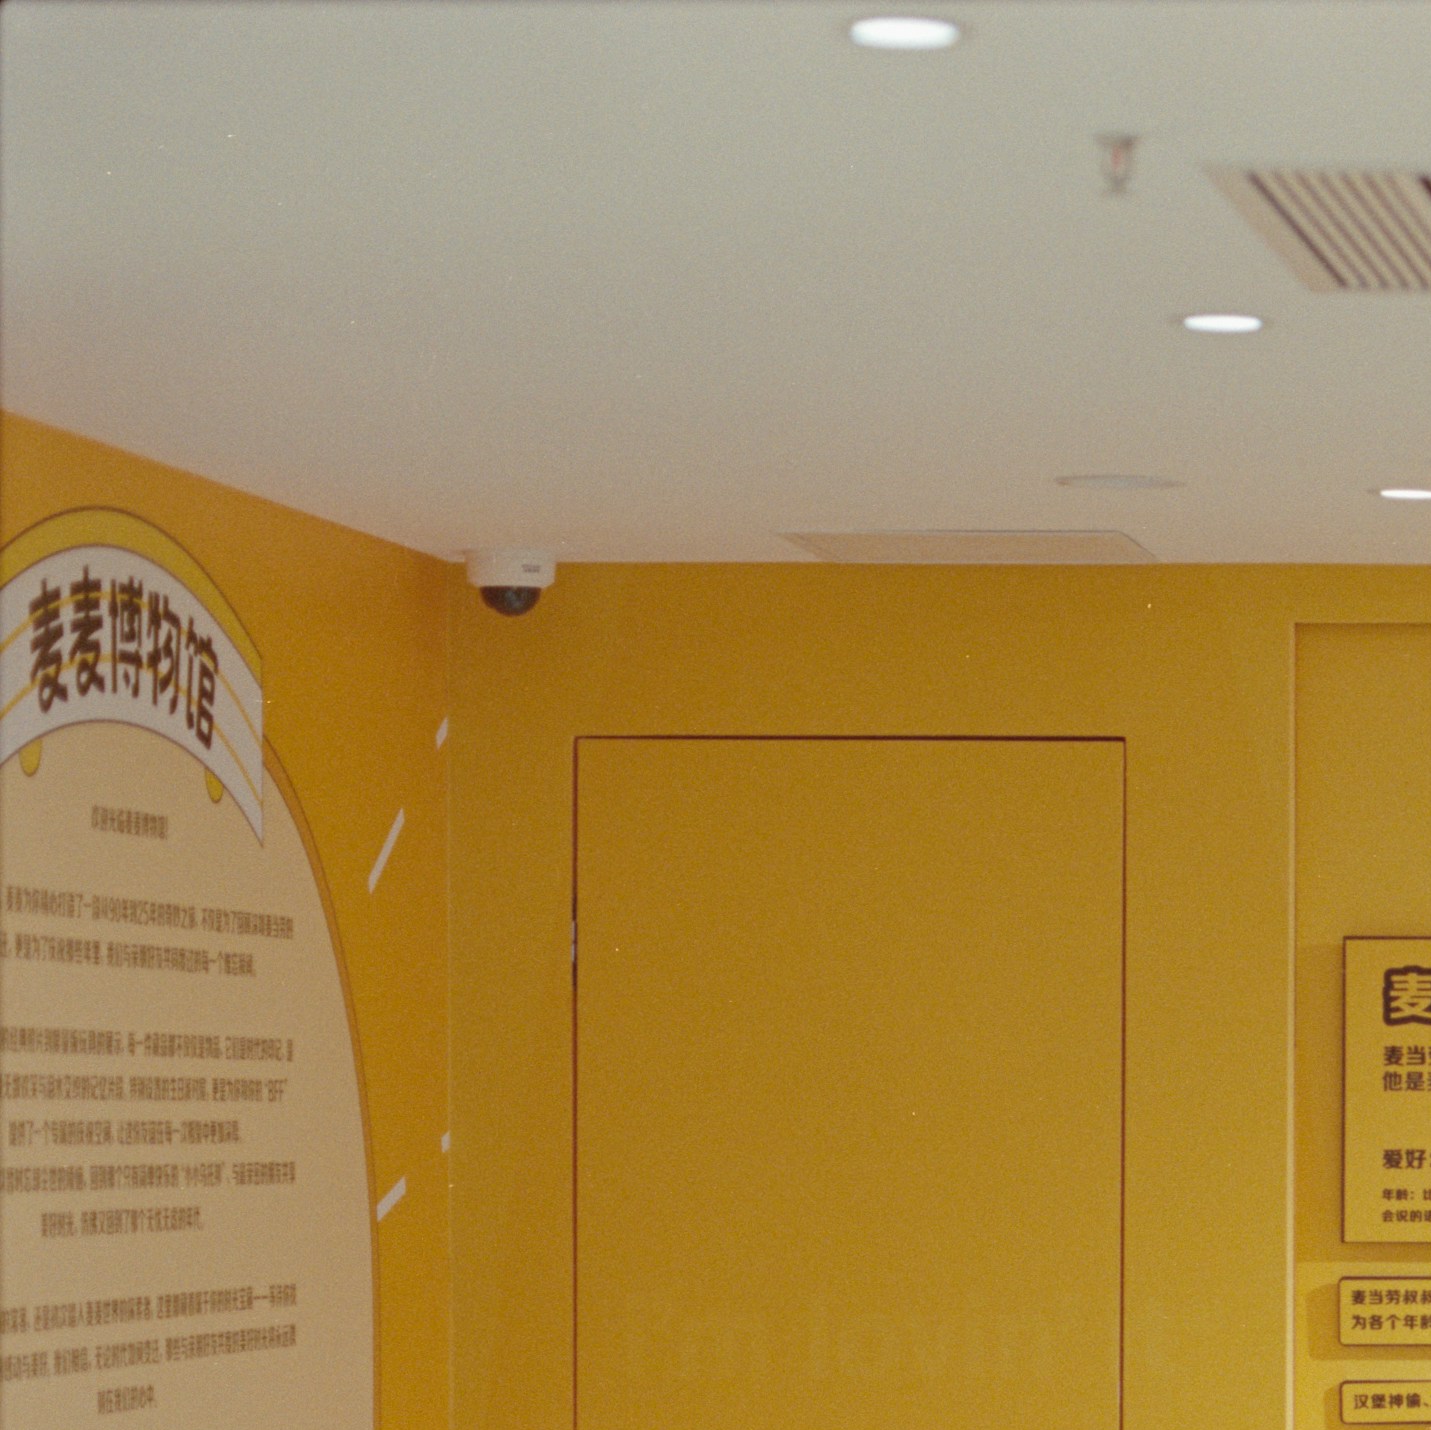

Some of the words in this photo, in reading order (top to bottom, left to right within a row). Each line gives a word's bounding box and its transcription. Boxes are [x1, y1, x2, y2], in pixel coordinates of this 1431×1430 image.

[28, 565, 219, 751] 麦麦博物馆
